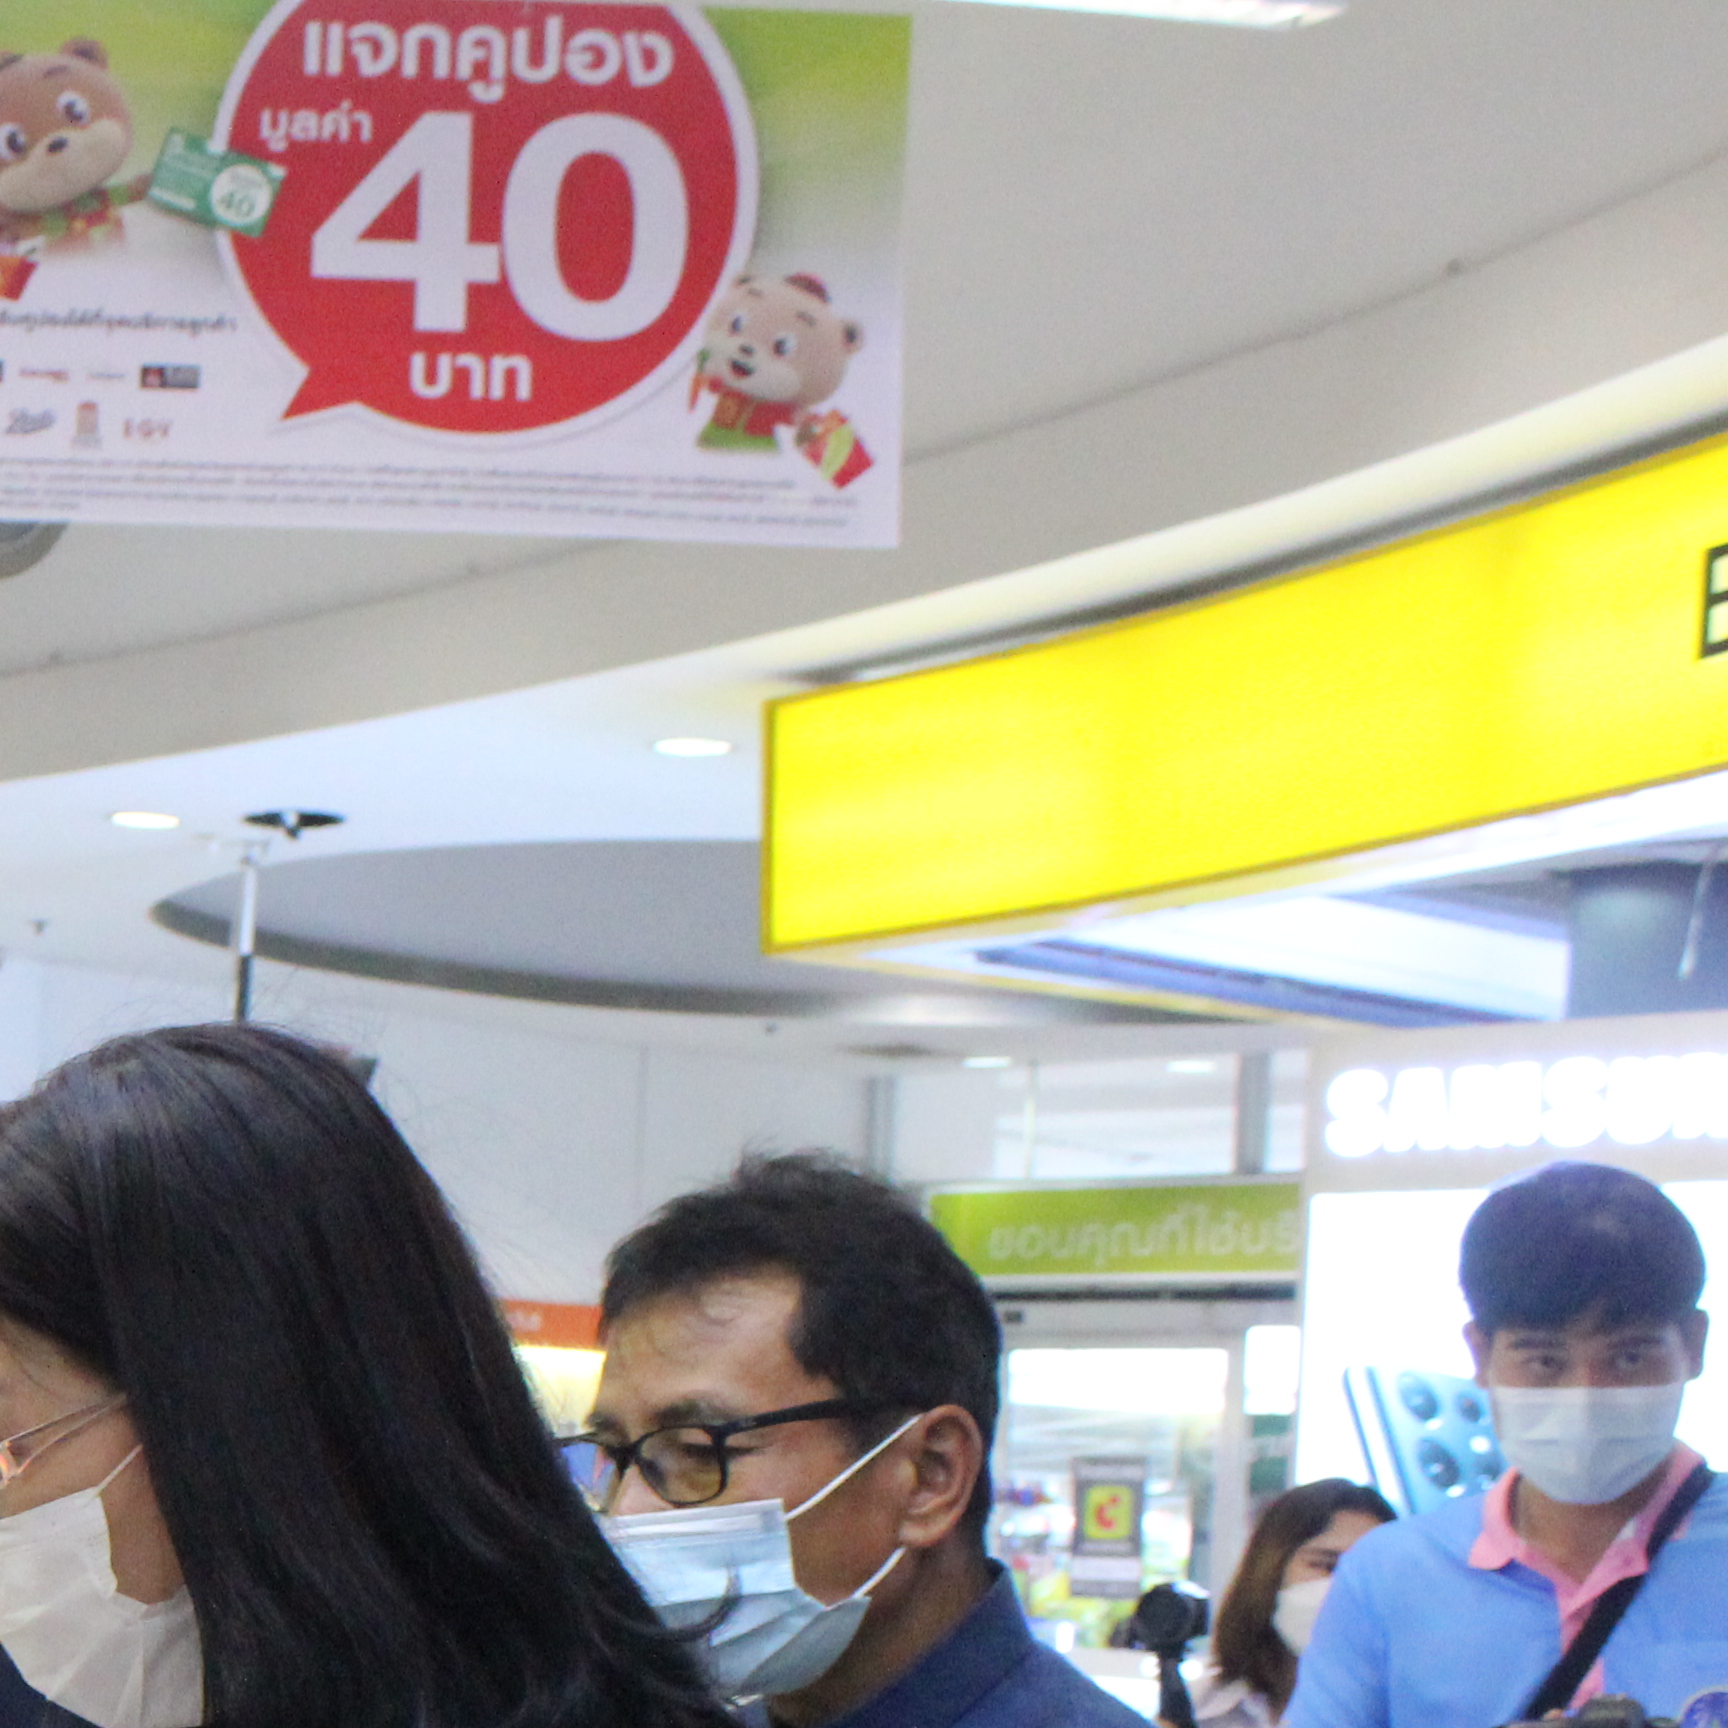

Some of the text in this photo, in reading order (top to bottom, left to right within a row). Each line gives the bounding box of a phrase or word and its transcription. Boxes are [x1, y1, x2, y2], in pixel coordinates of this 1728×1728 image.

[303, 22, 674, 102] แจกคูปอง
[259, 98, 372, 151] มูลค่า
[310, 110, 688, 343] 40
[410, 350, 532, 401] บาท
